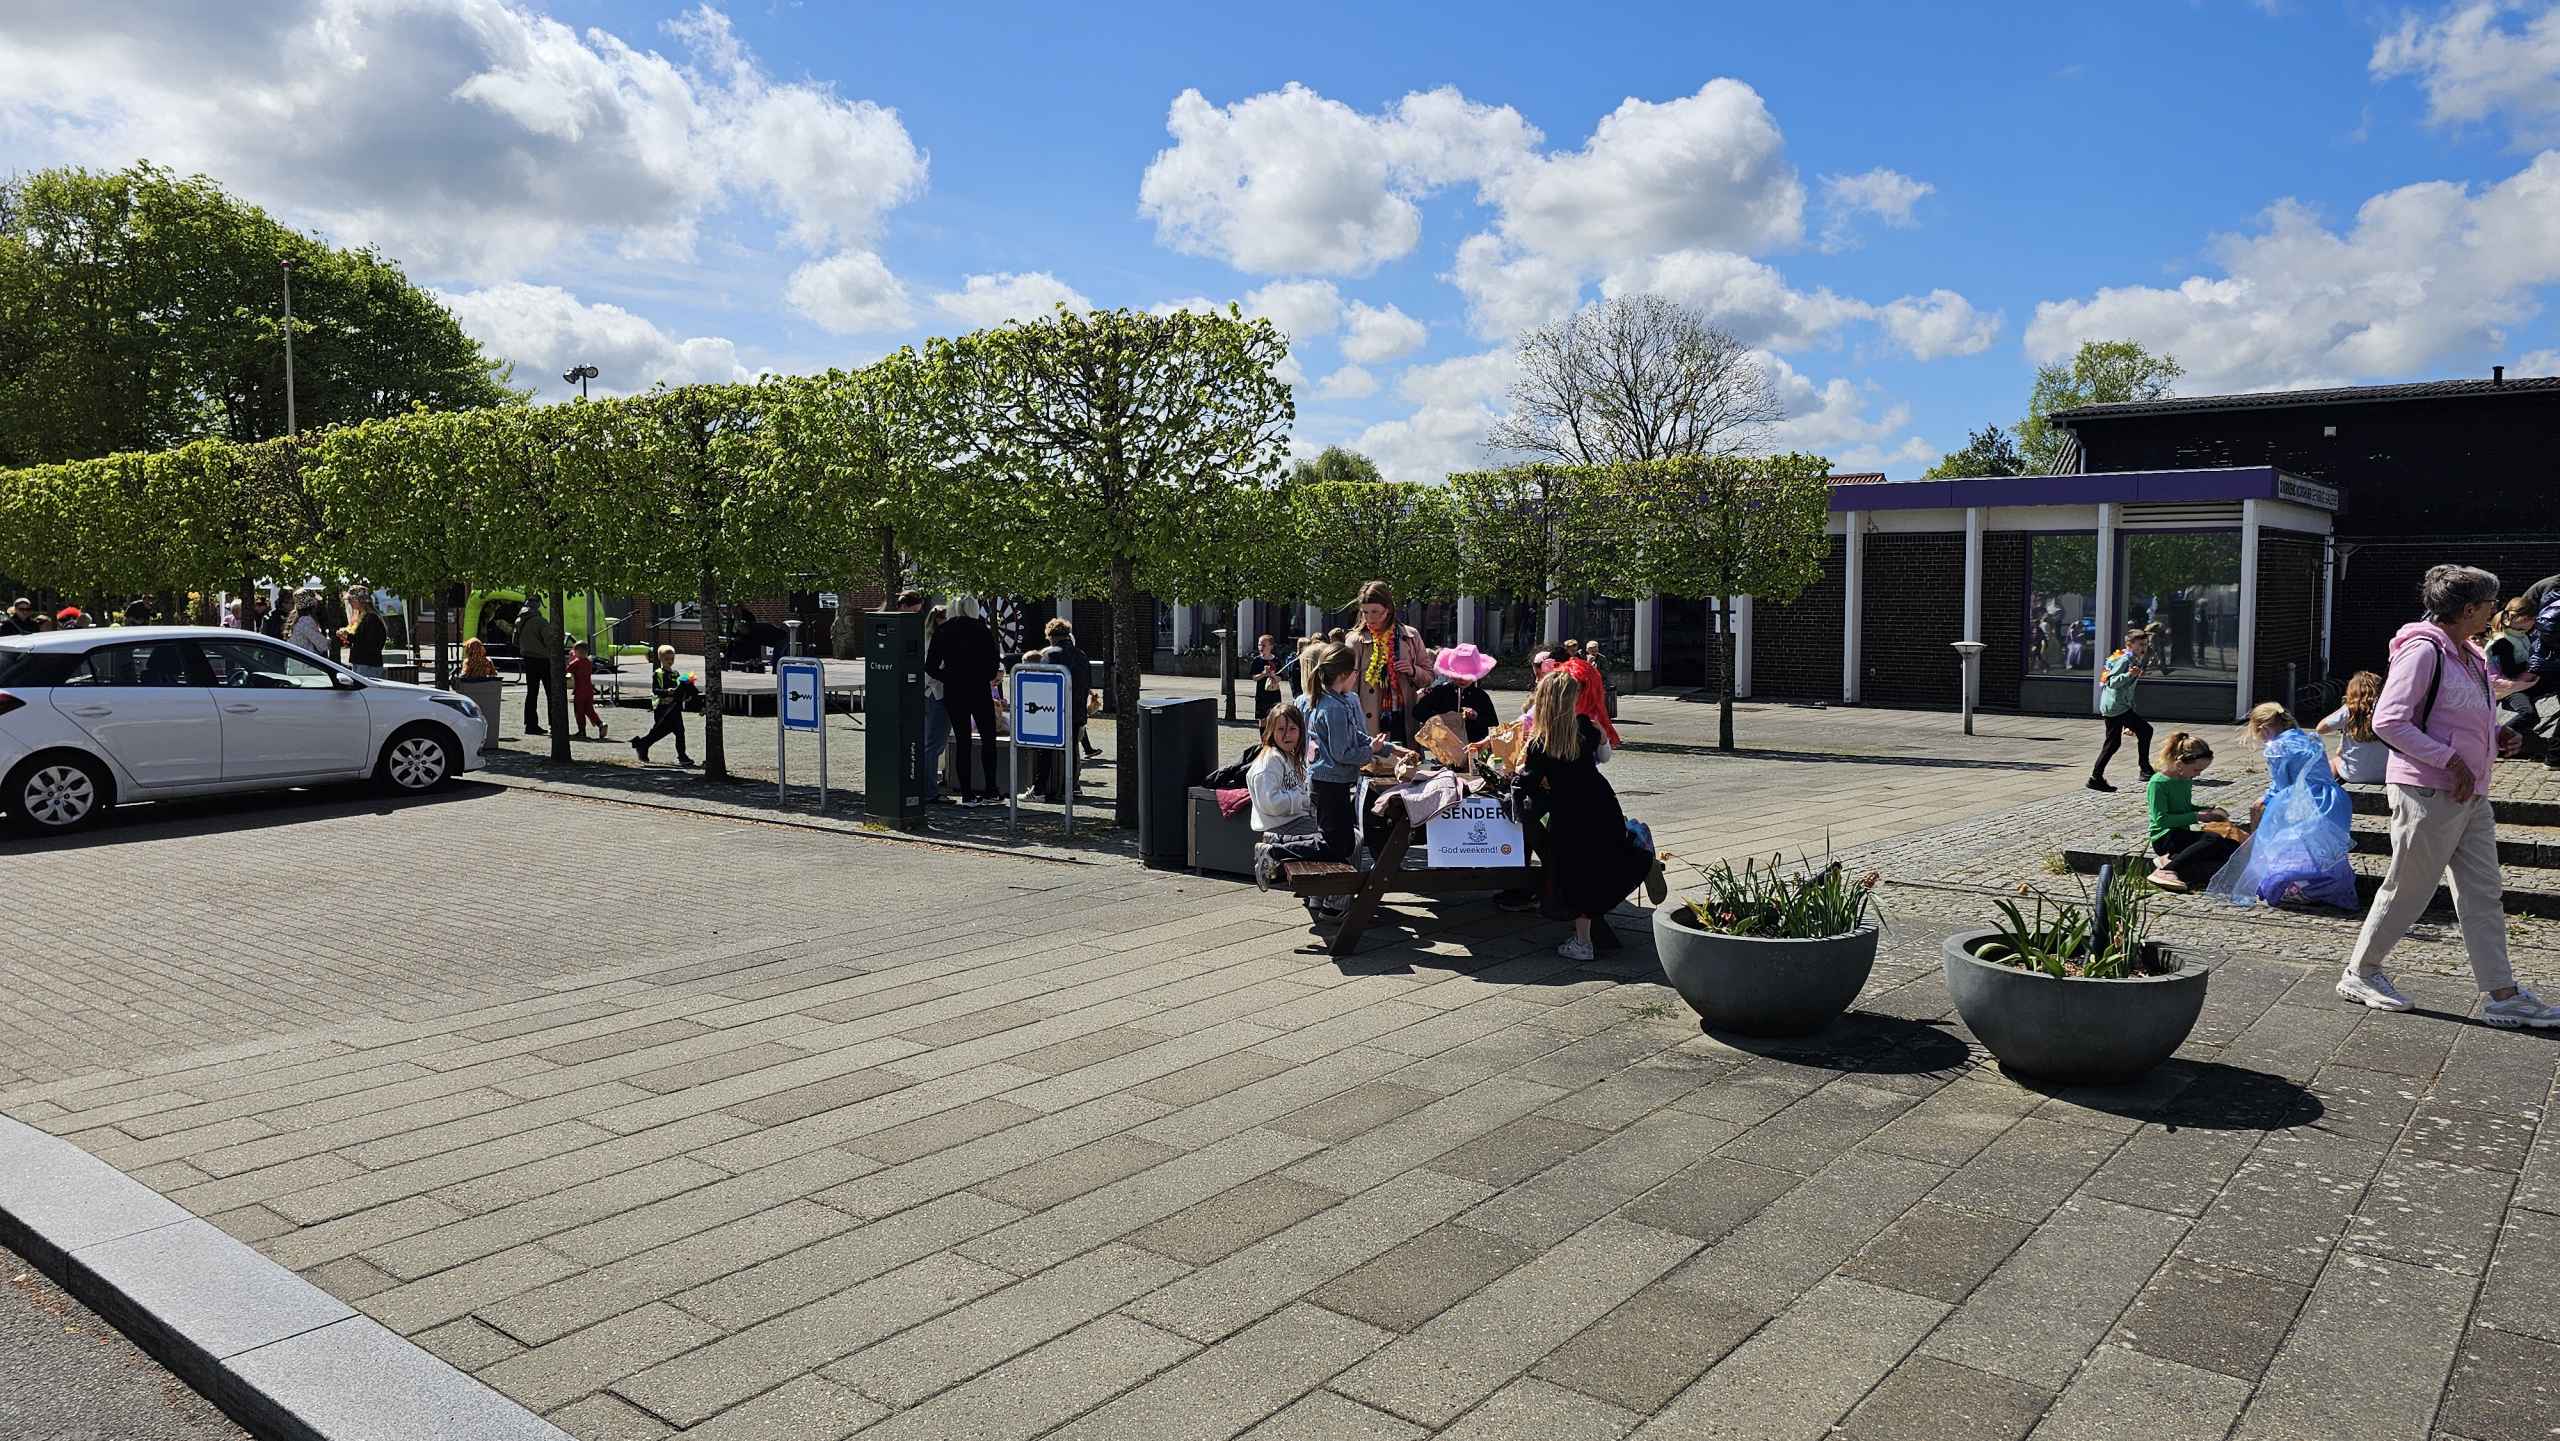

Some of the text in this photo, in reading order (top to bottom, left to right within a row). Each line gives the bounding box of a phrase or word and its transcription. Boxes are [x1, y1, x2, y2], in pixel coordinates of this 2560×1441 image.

[870, 661, 893, 671] Clever
[1440, 806, 1506, 820] SENDER
[1459, 845, 1498, 854] weekend!
